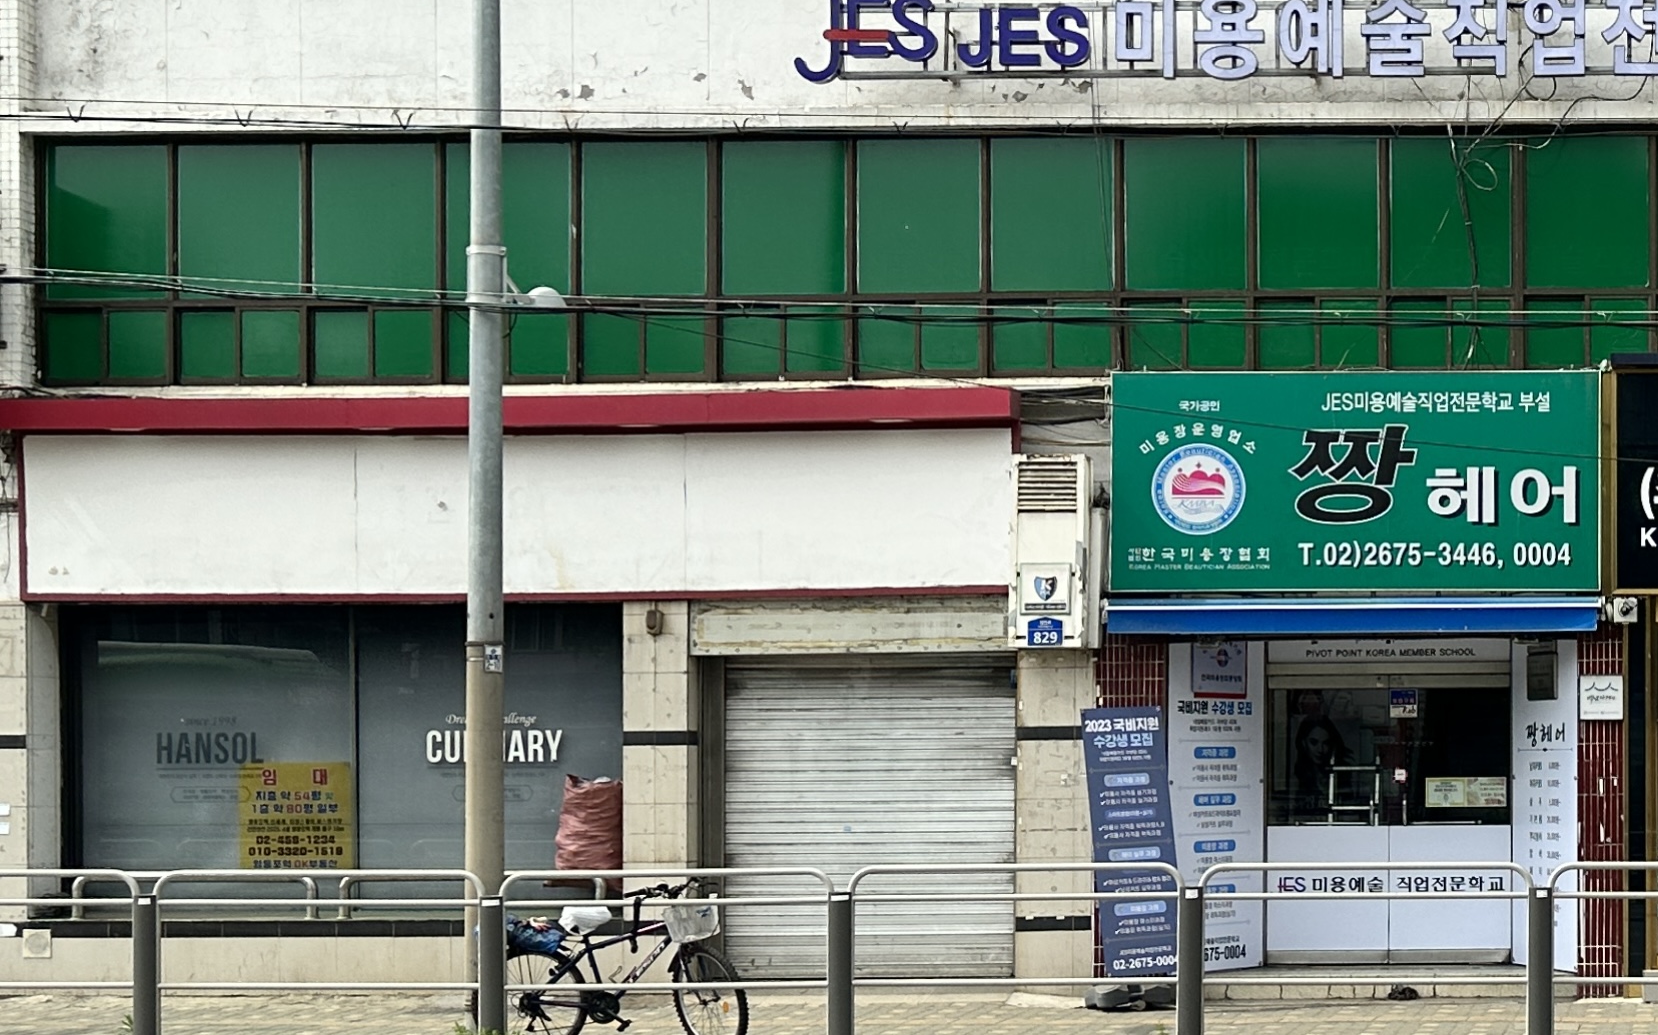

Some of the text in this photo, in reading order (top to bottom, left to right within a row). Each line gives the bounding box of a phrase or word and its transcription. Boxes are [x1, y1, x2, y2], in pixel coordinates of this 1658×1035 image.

[1179, 400, 1220, 411] 국가공인
[1321, 391, 1551, 413] JES미용예술직업전문학교 부설
[1288, 423, 1580, 525] 짱 헤어
[1513, 542, 1571, 566] 0004
[1033, 632, 1058, 644] 829
[1306, 648, 1476, 658] PIVOT POINT KOREA MEMBER SCHOOL
[1177, 701, 1252, 715] 국비지원 수강생 모집
[1085, 717, 1159, 732] 2023 국비지원
[156, 732, 264, 764] HANSOL
[1093, 733, 1153, 748] 수강생 모집
[1312, 877, 1383, 893] 미용예술
[1396, 876, 1505, 892] 직업전문학교
[1204, 944, 1246, 961] 675-0004
